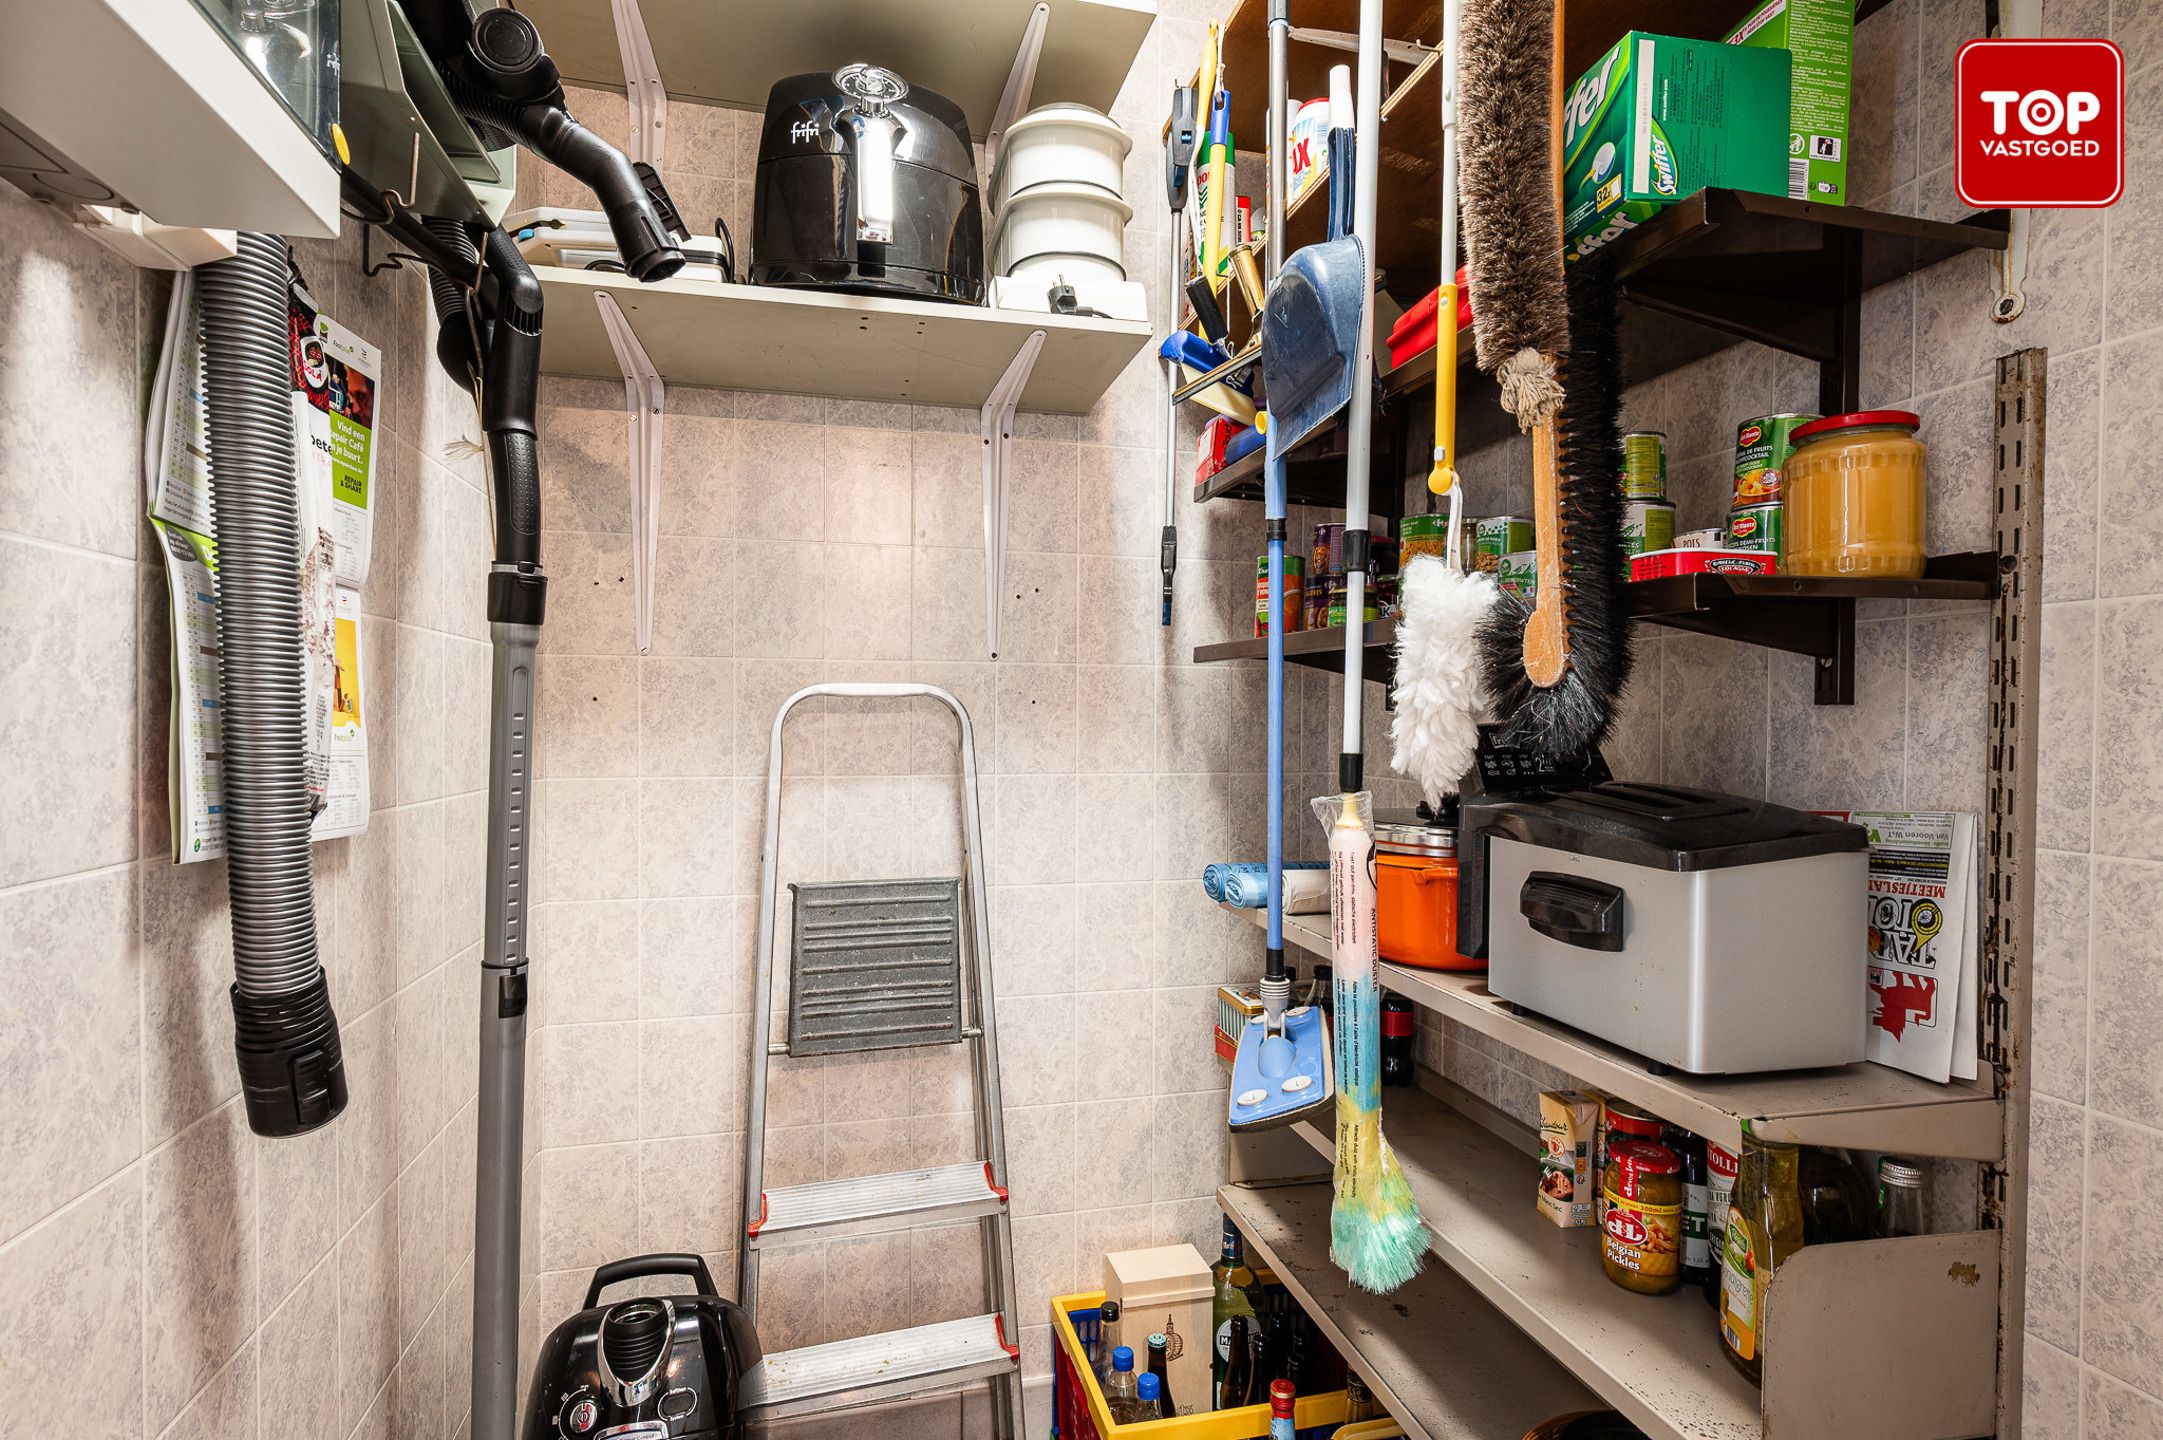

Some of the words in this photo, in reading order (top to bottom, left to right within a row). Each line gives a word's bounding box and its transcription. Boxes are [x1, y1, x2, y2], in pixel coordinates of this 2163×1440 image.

[790, 120, 820, 144] frifri
[1652, 134, 1677, 195] Swiffer
[337, 420, 352, 435] Vind
[1754, 445, 1773, 453] FRUITS
[1905, 832, 1934, 840] Vooren
[1936, 833, 1949, 841] Van
[1606, 1237, 1641, 1259] Belgian
[1607, 1249, 1640, 1270] Pickles
